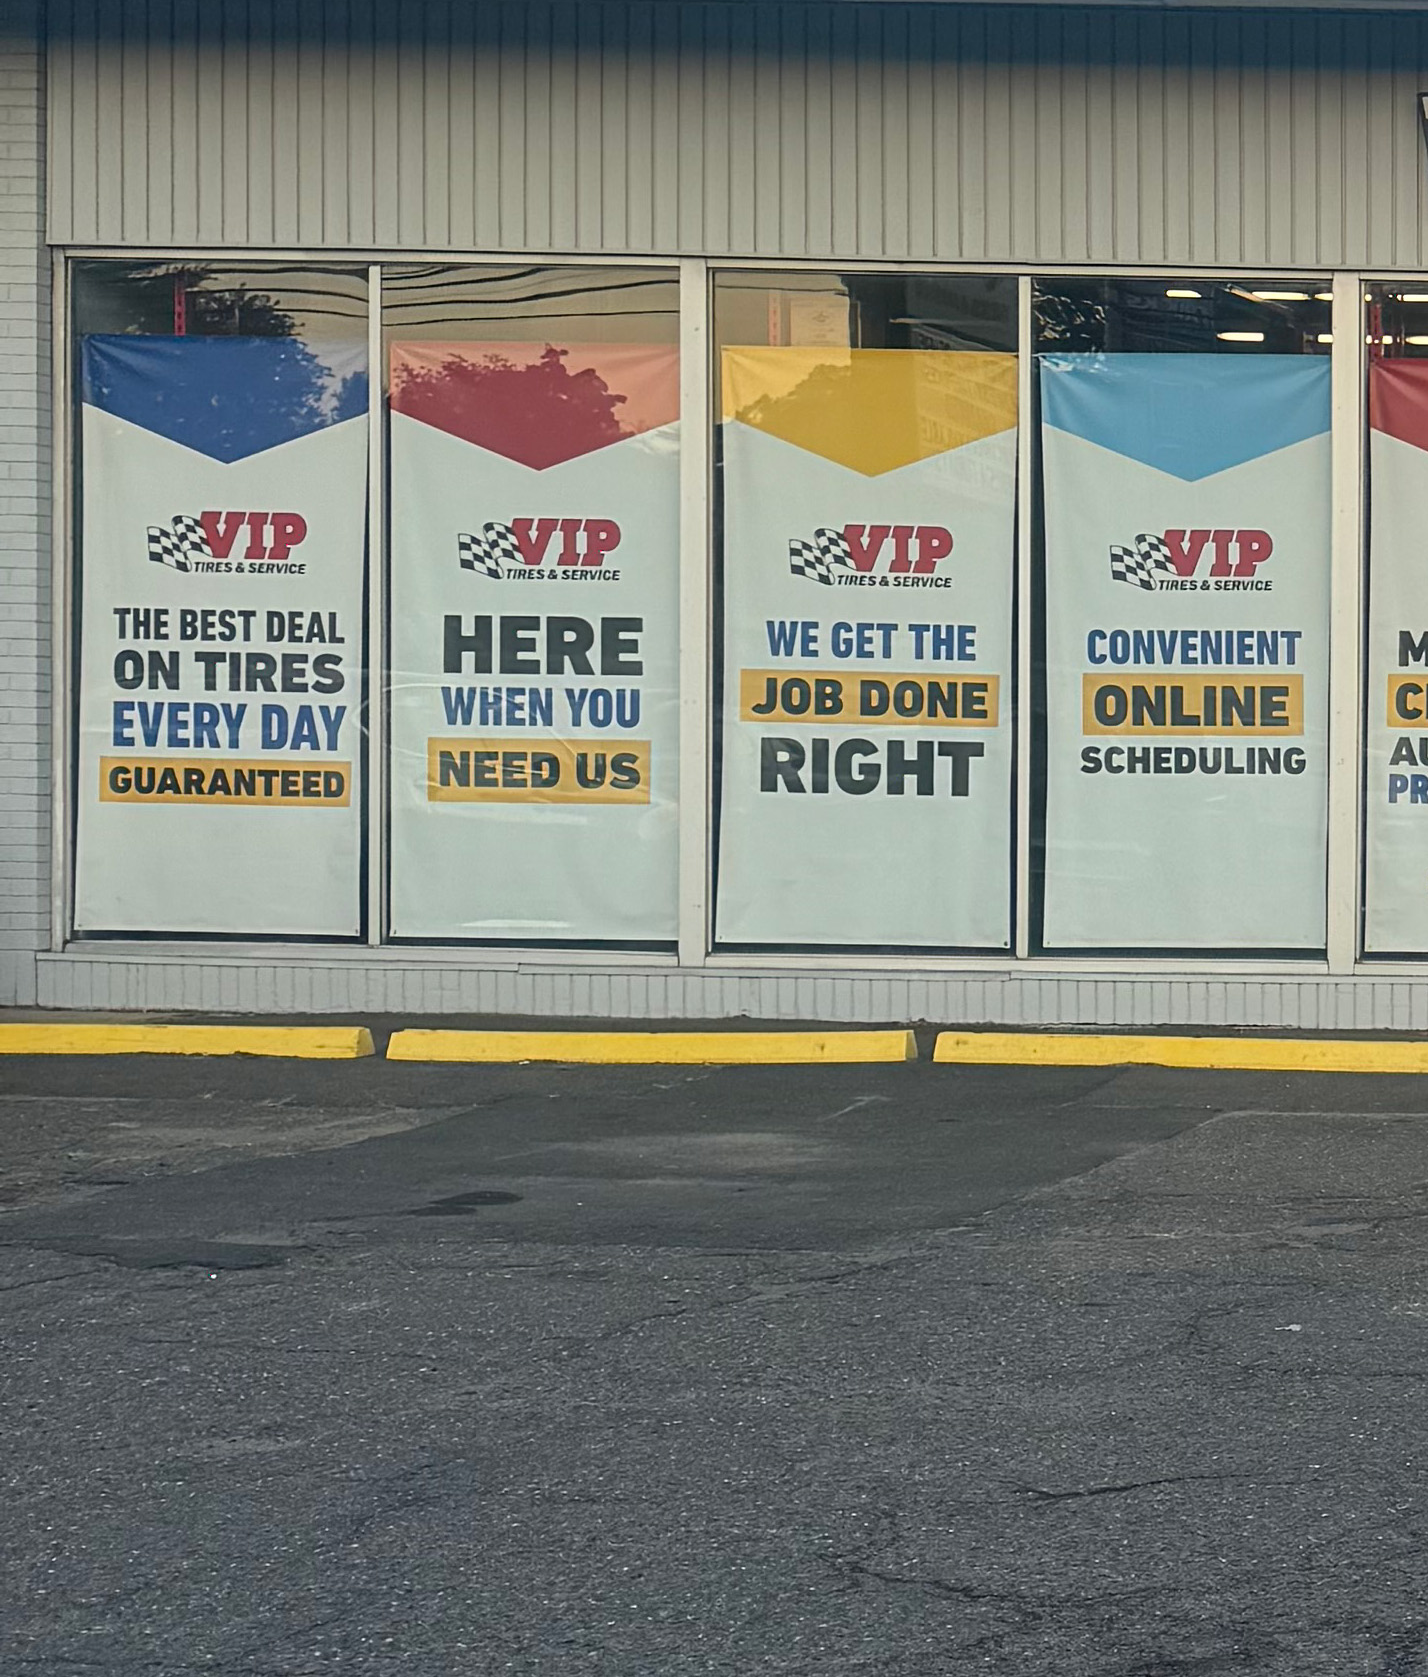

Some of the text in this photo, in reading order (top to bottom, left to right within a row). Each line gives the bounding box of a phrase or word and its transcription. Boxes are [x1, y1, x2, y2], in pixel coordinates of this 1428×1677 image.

[198, 511, 308, 561] VIP
[510, 518, 622, 567] VIP
[843, 524, 954, 574] VIP
[1162, 529, 1274, 578] VIP
[194, 561, 307, 575] TIRES & SERVICE
[506, 568, 621, 582] TIRES & SERVICE
[837, 575, 953, 589] TIRES & SERVICE
[1158, 579, 1274, 592] TIRES & SERVICE
[113, 607, 345, 644] THE BEST DEAL
[443, 615, 644, 677] HERE
[766, 619, 977, 661] WE GET THE
[1086, 628, 1302, 666] CONVENIENT
[113, 649, 345, 694] ON TIRES
[441, 685, 641, 729] WHEN YOU
[751, 677, 989, 720] JOB DONE
[1093, 685, 1290, 728] ONLINE
[112, 700, 347, 751] EVERY DAY
[109, 766, 345, 799] GUARANTEED
[439, 750, 641, 789] NEED US
[760, 736, 985, 797] RIGHT
[1080, 746, 1307, 776] SCHEDULING
